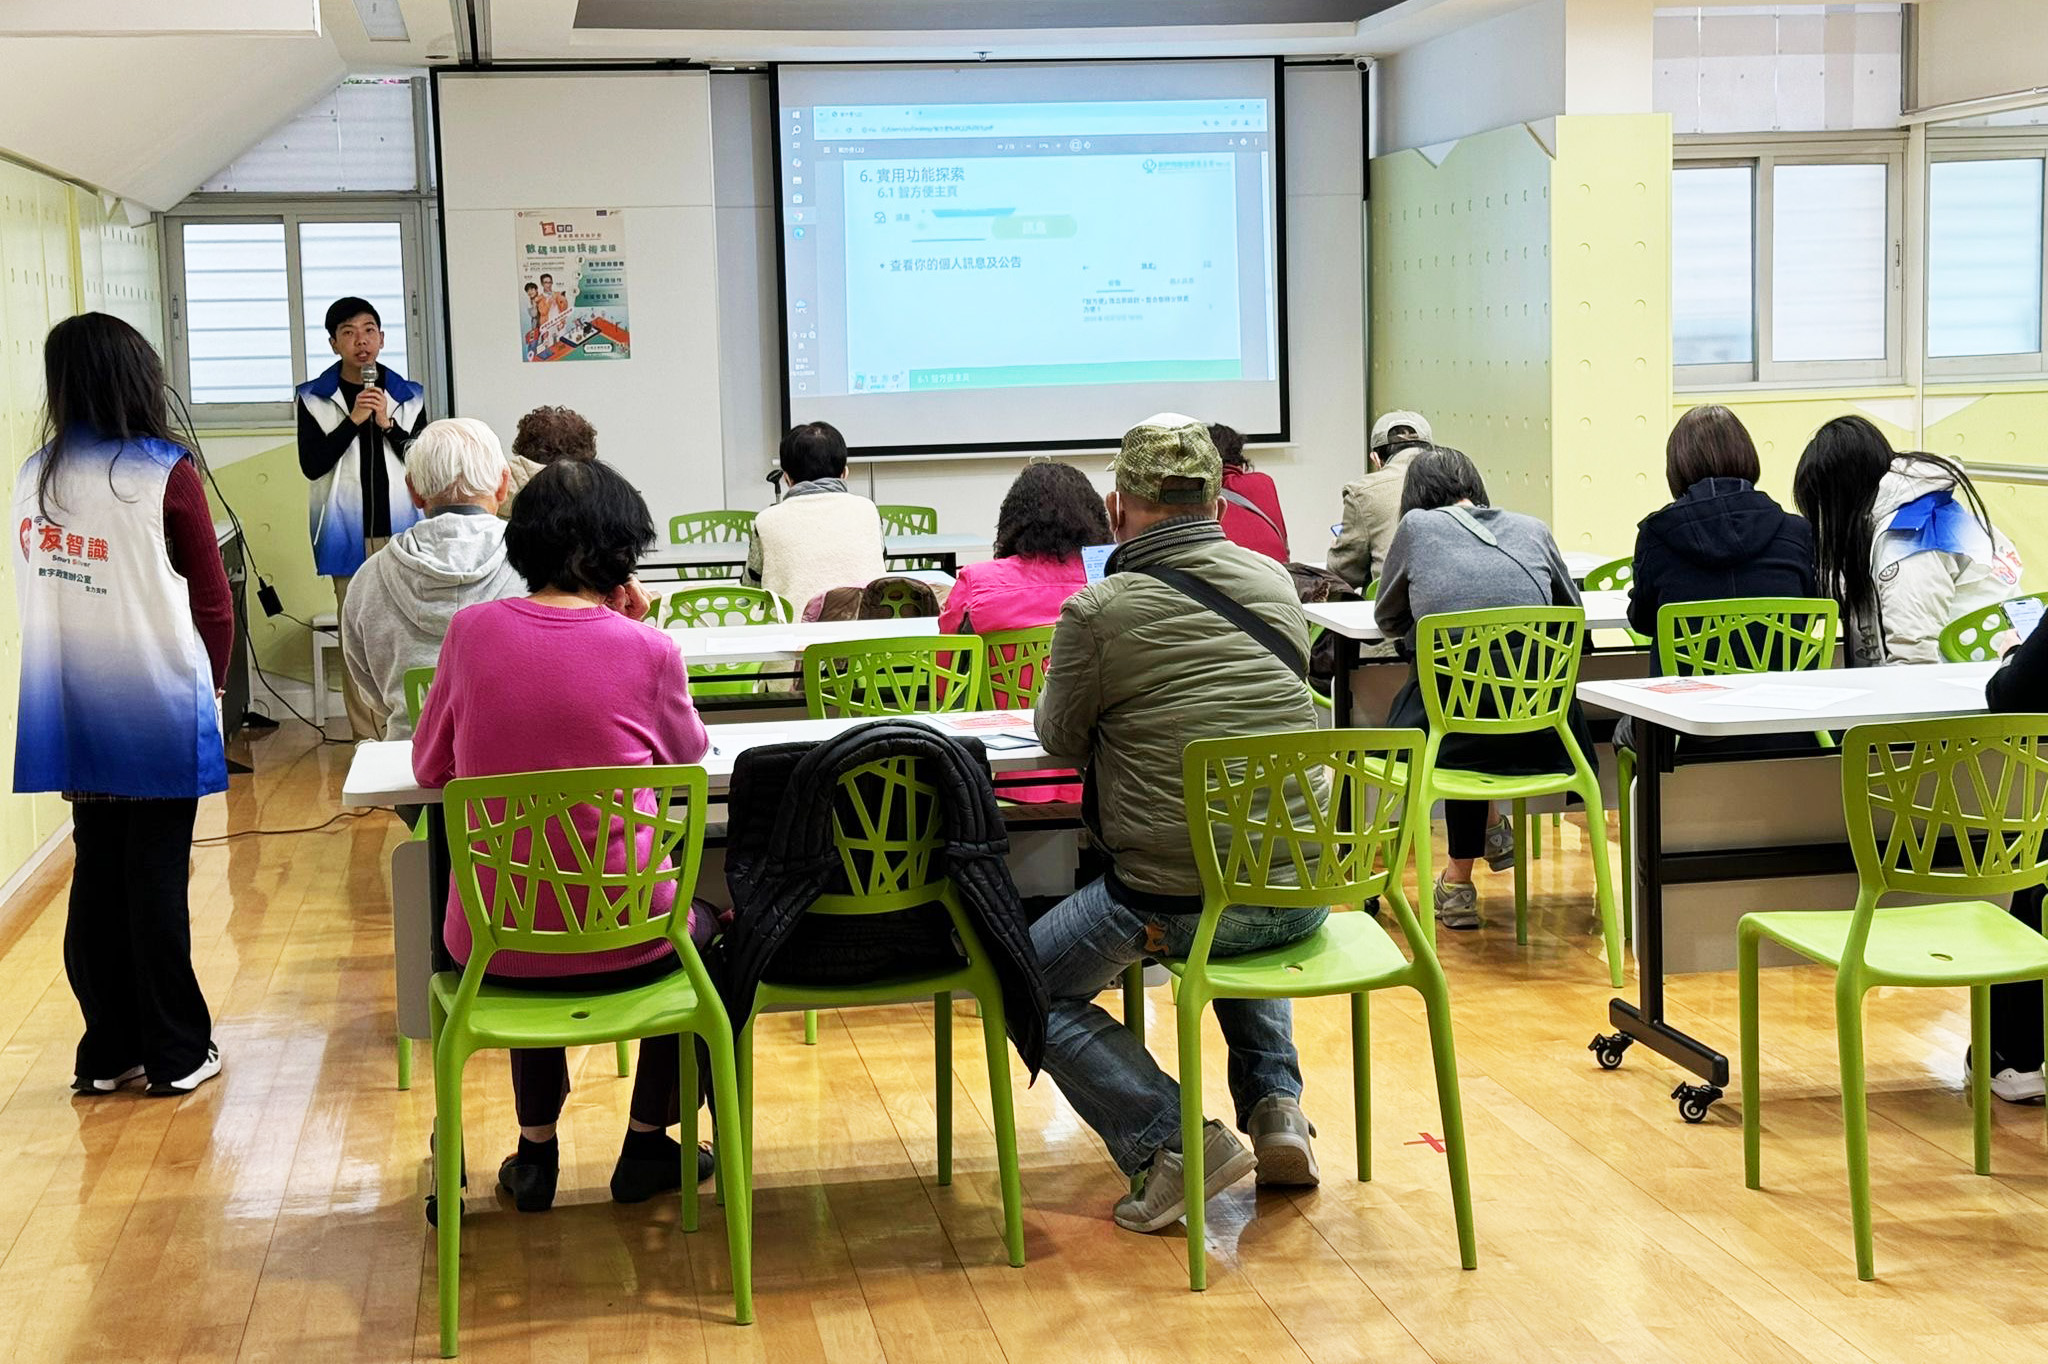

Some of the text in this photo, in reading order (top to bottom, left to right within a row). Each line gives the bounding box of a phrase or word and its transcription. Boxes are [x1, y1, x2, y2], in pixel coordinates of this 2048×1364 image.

[859, 167, 965, 183] 6. 實用功能探索
[877, 186, 958, 198] 6.1 智方便主頁
[890, 256, 1022, 272] 查看你的個人訊息及公告
[38, 525, 109, 562] 友智識
[52, 554, 71, 564] Smart
